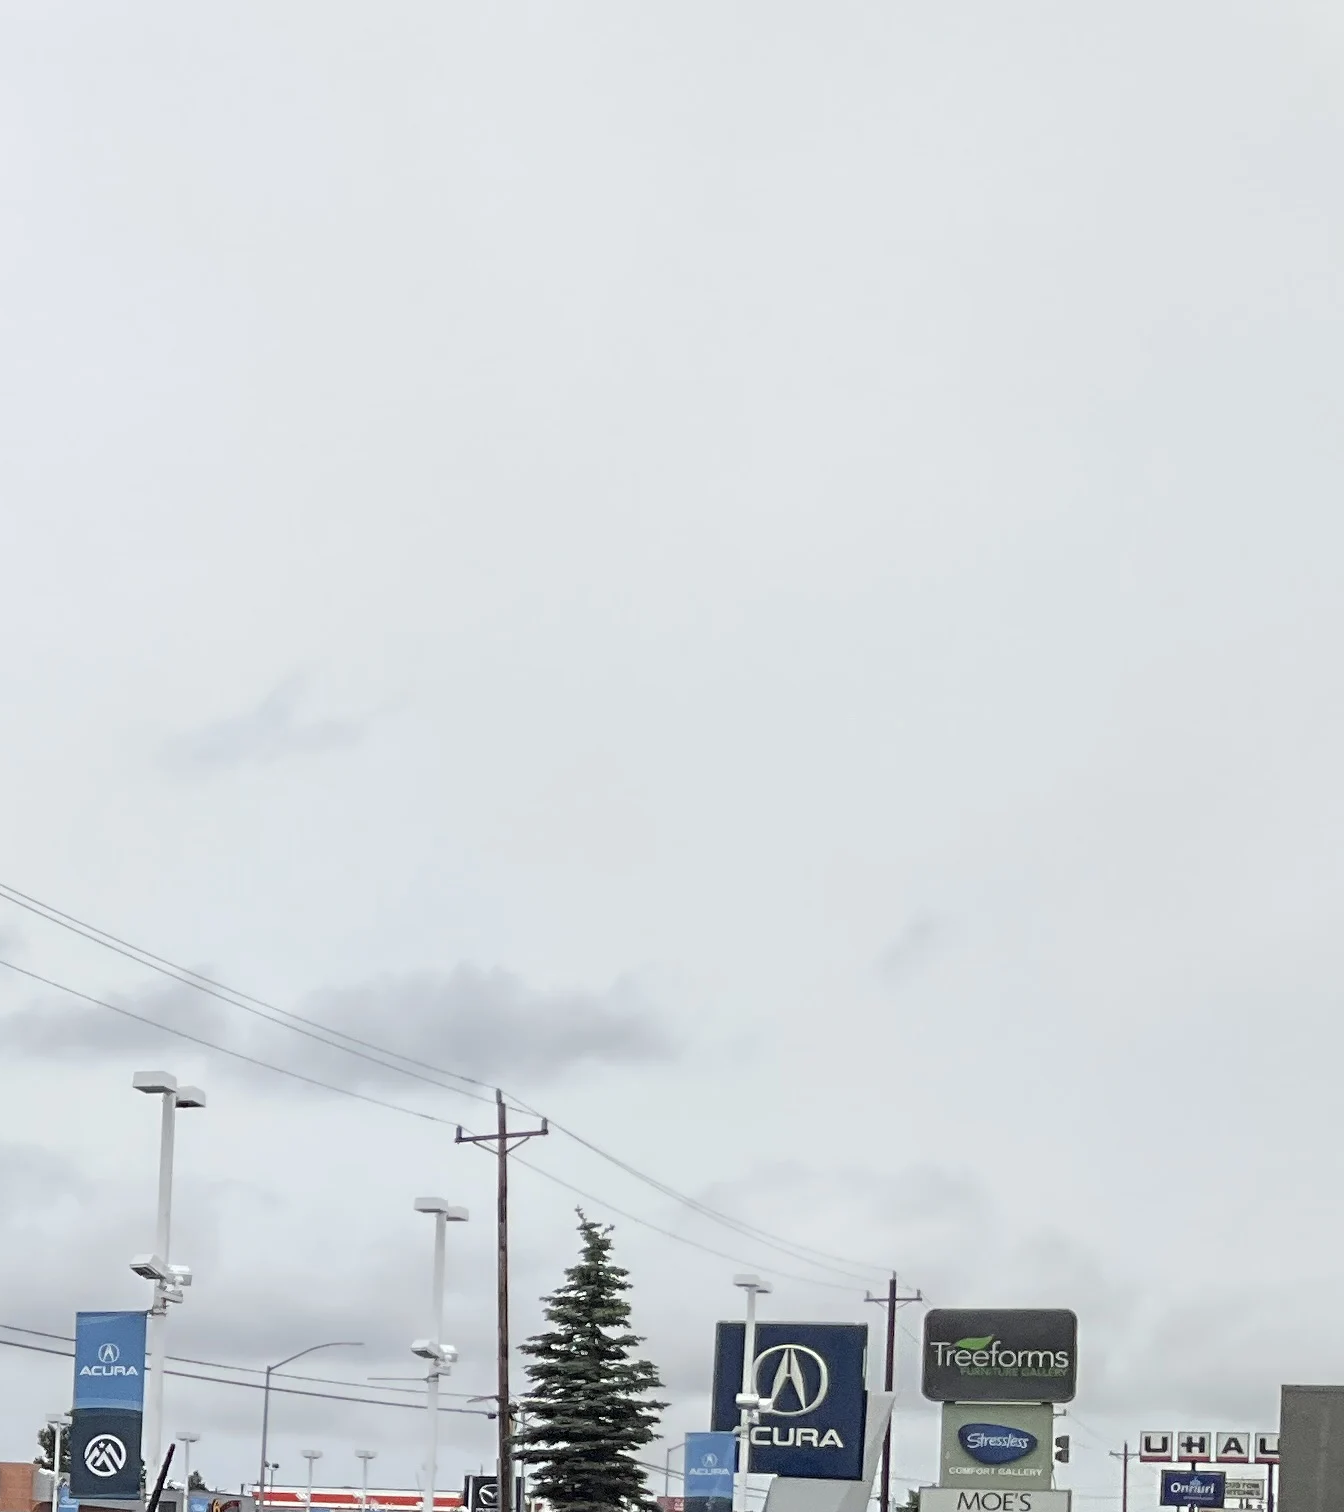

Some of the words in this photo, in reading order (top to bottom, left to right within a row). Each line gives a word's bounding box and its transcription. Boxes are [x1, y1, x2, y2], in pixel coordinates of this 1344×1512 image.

[930, 1340, 1069, 1368] Treeforms
[79, 1365, 139, 1376] ACURA
[749, 1426, 844, 1448] CURA
[966, 1433, 1030, 1449] Stressless
[688, 1468, 731, 1476] ACURA
[948, 1466, 995, 1476] COMFORT
[998, 1467, 1043, 1477] GALLERY
[956, 1492, 1032, 1512] MOE'S
